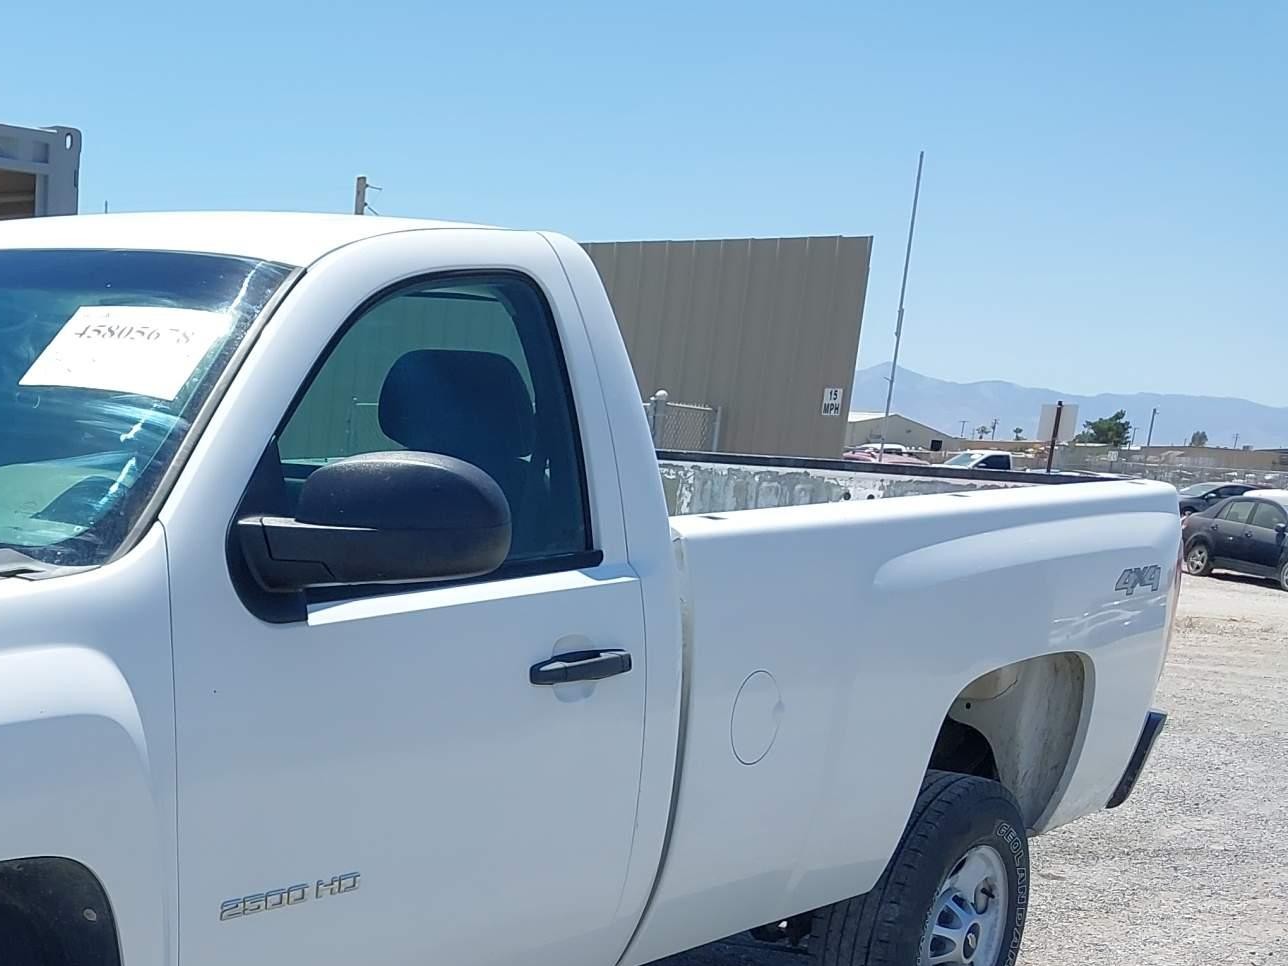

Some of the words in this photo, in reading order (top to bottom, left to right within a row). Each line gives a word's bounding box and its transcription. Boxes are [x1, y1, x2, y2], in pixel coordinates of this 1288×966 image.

[829, 390, 838, 401] 15
[823, 403, 840, 414] MPH
[220, 883, 310, 921] 2500
[315, 872, 361, 899] HD
